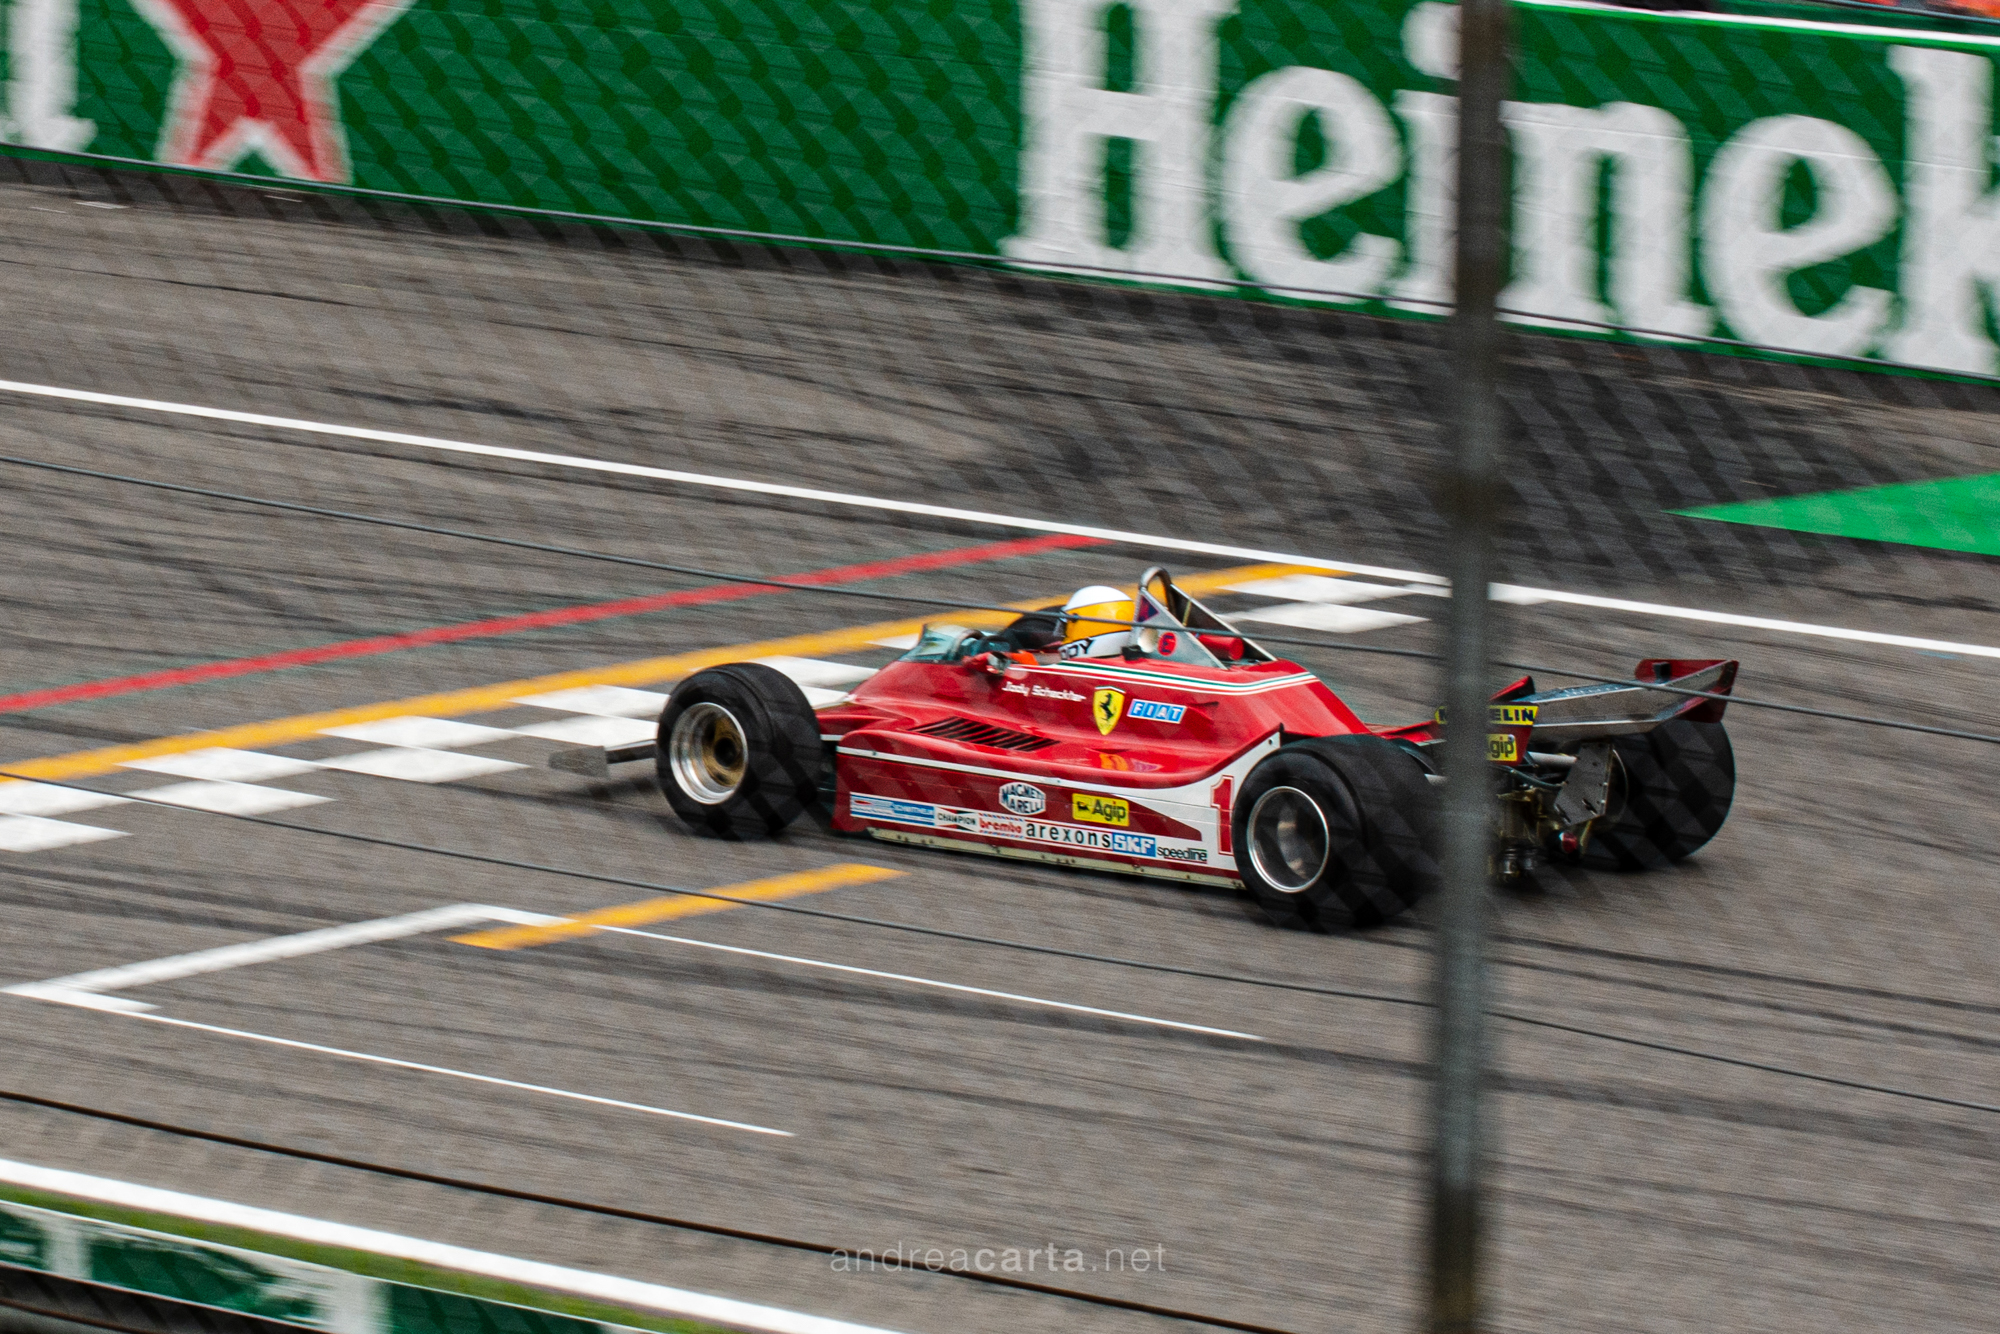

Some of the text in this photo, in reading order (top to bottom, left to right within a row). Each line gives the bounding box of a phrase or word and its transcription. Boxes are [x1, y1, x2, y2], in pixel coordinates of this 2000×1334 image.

[1131, 702, 1183, 722] FIAT
[937, 812, 977, 826] CHAMPION
[1091, 798, 1126, 822] Agip
[1210, 775, 1234, 856] 1
[978, 817, 1022, 834] brembo
[1025, 822, 1112, 849] arexons
[1113, 834, 1156, 854] SKF
[1156, 846, 1208, 863] speedline
